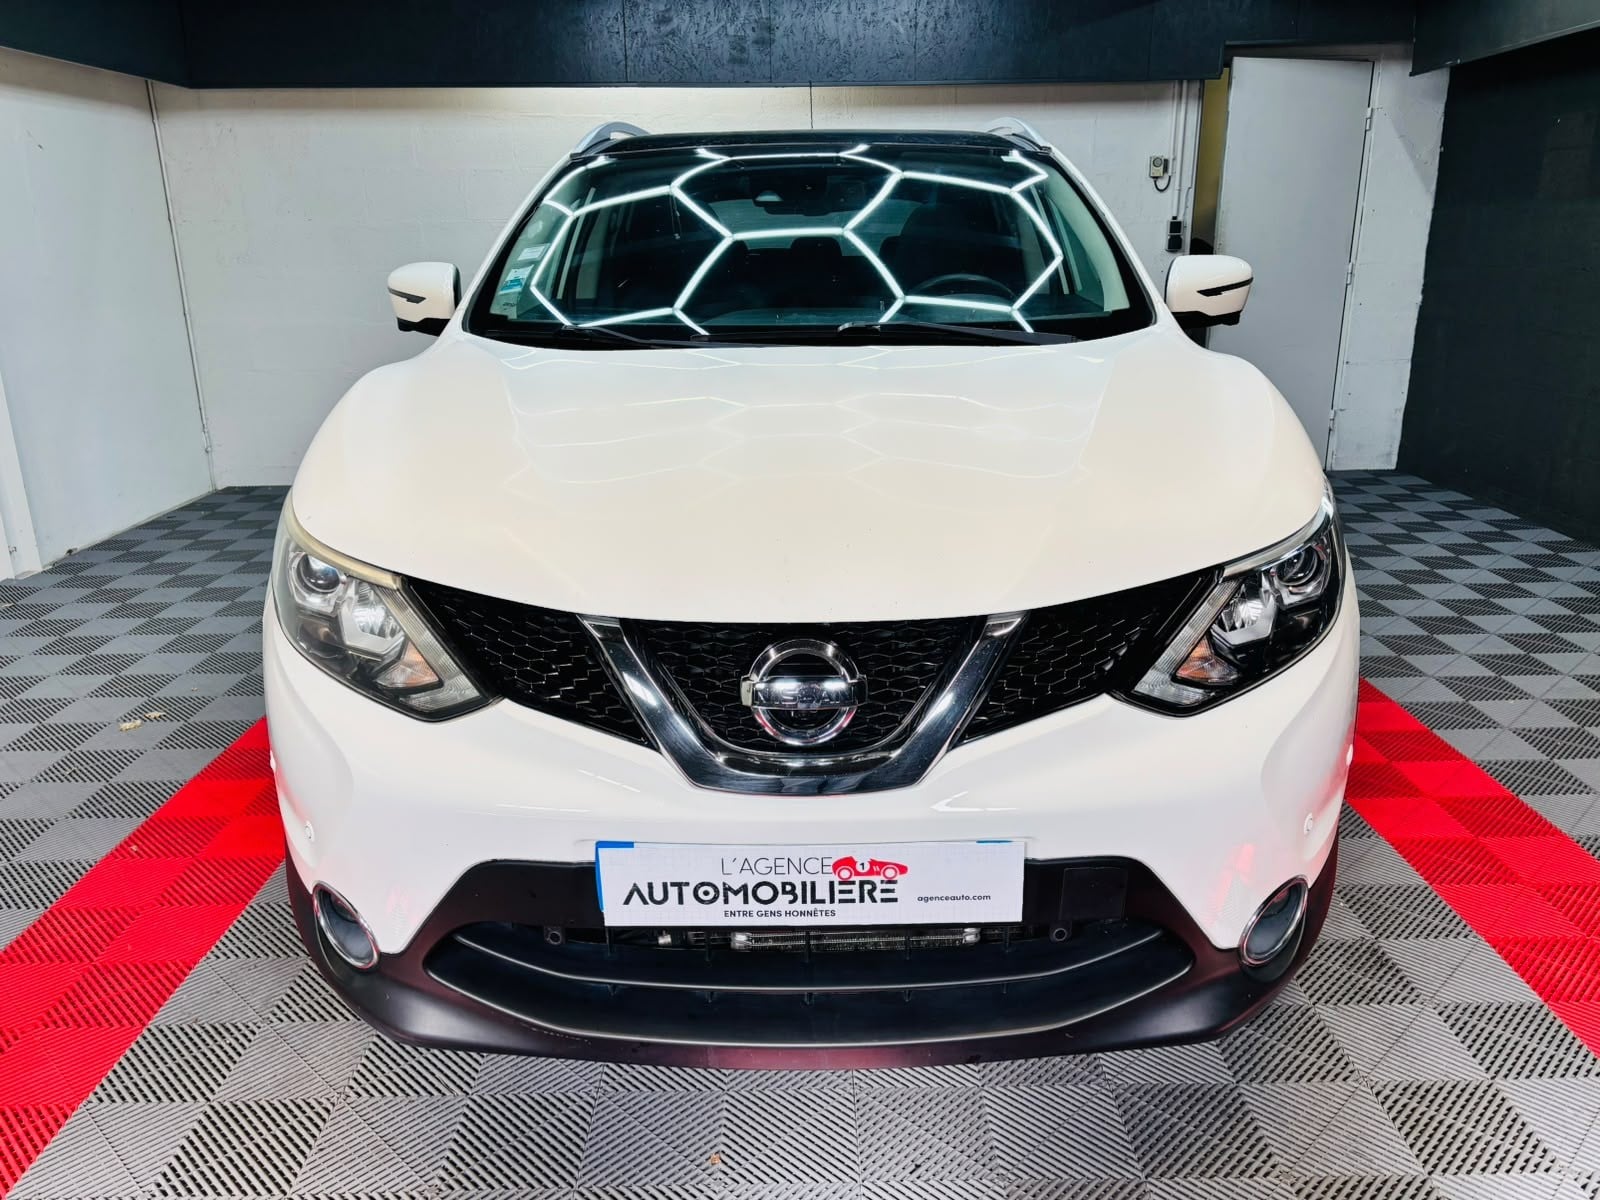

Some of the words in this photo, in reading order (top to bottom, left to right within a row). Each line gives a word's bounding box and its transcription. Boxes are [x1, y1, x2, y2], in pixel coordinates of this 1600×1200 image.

[721, 856, 833, 876] L'AGENCE
[859, 862, 866, 871] 1
[917, 894, 992, 904] agenceauto.com
[724, 910, 753, 918] ENTRE
[756, 910, 783, 918] GENS
[784, 907, 837, 918] HONNÊTES
